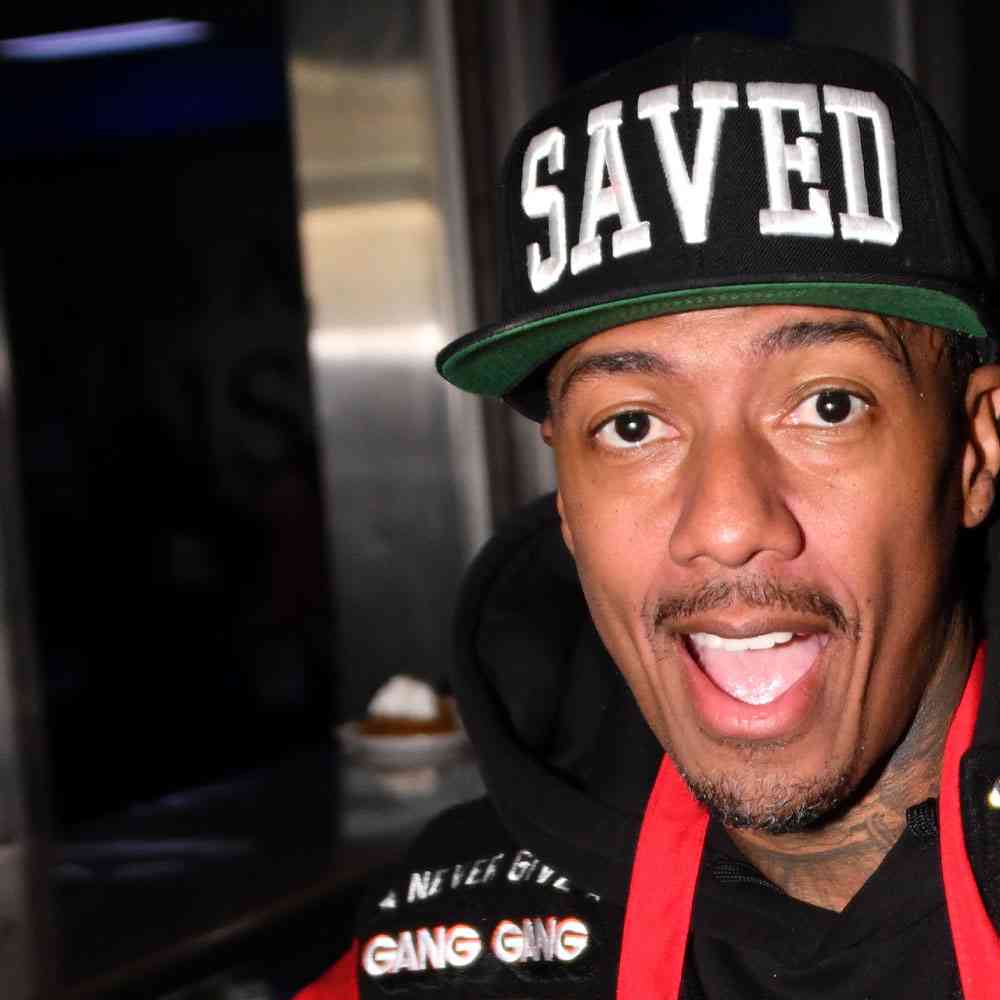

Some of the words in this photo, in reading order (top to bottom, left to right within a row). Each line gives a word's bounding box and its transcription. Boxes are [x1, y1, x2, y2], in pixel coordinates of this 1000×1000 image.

[521, 81, 902, 294] SAVED
[363, 925, 482, 976] GANG
[492, 917, 588, 964] GANG
